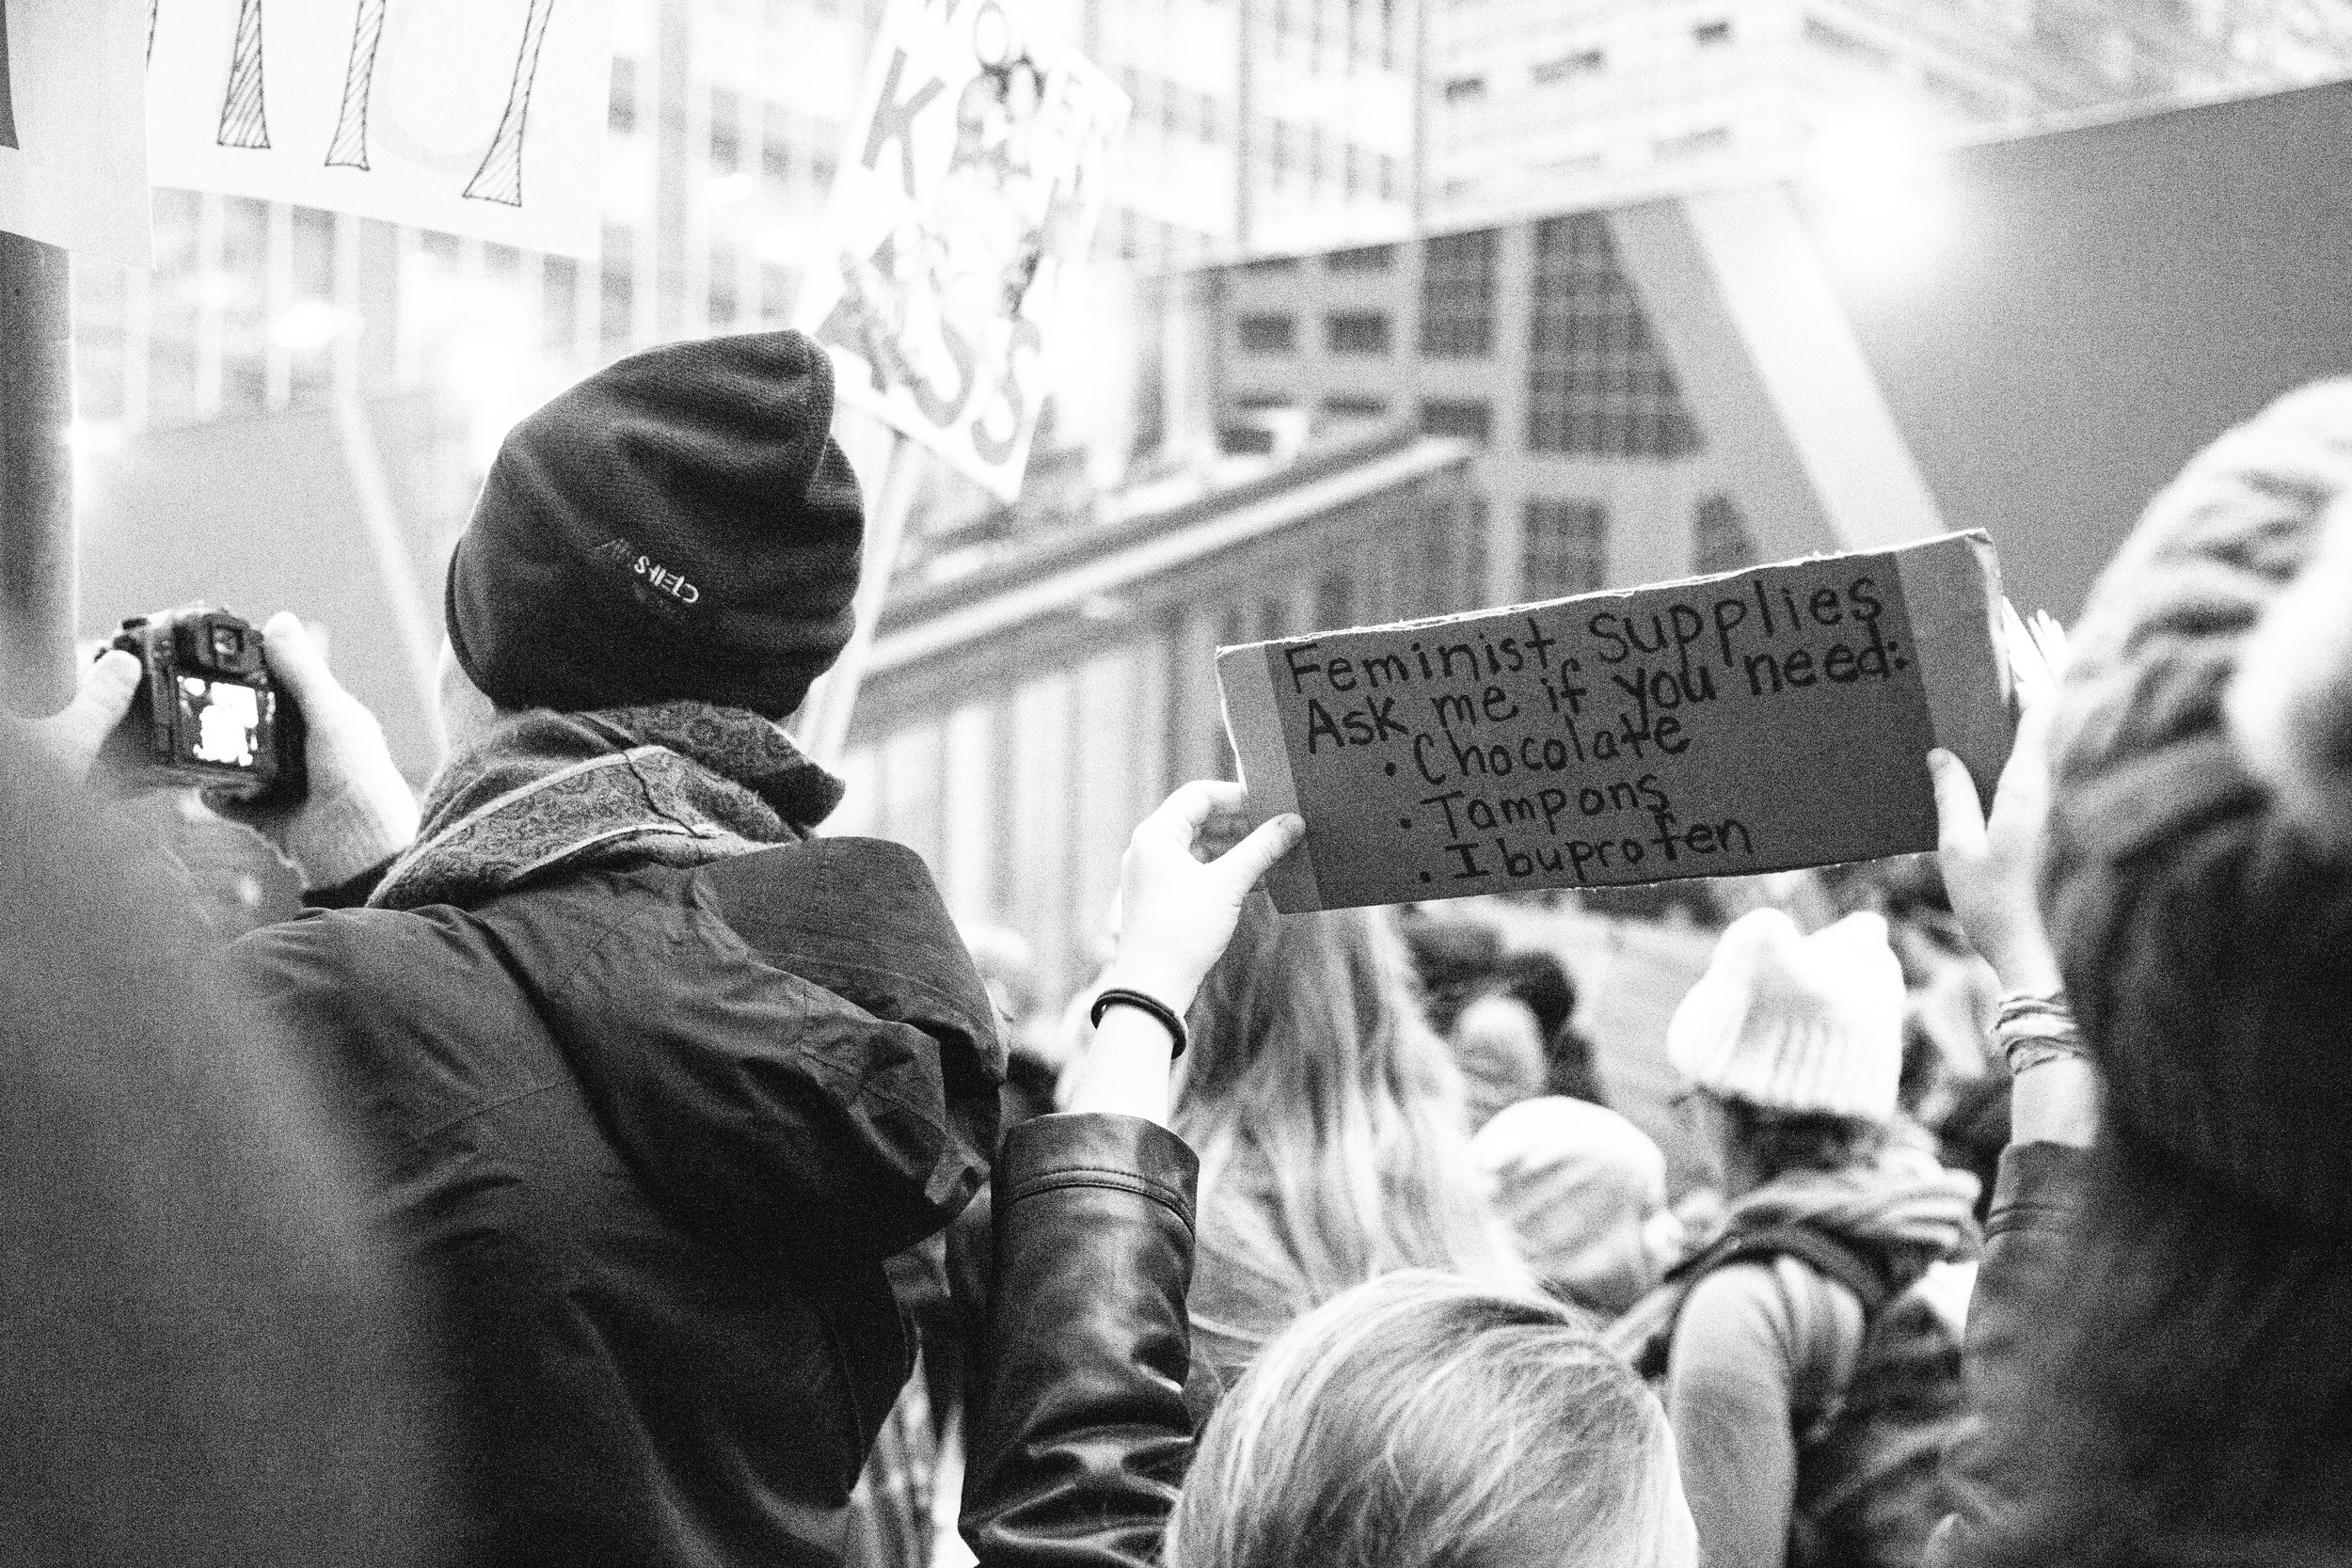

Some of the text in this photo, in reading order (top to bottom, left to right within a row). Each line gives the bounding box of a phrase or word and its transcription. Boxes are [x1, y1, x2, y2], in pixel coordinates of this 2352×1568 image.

[1284, 616, 1555, 694] Feminist
[1431, 686, 1519, 730] me
[1540, 659, 1588, 715] if
[1421, 773, 1670, 835] Tampons
[1444, 812, 1754, 882] Ibuprofen
